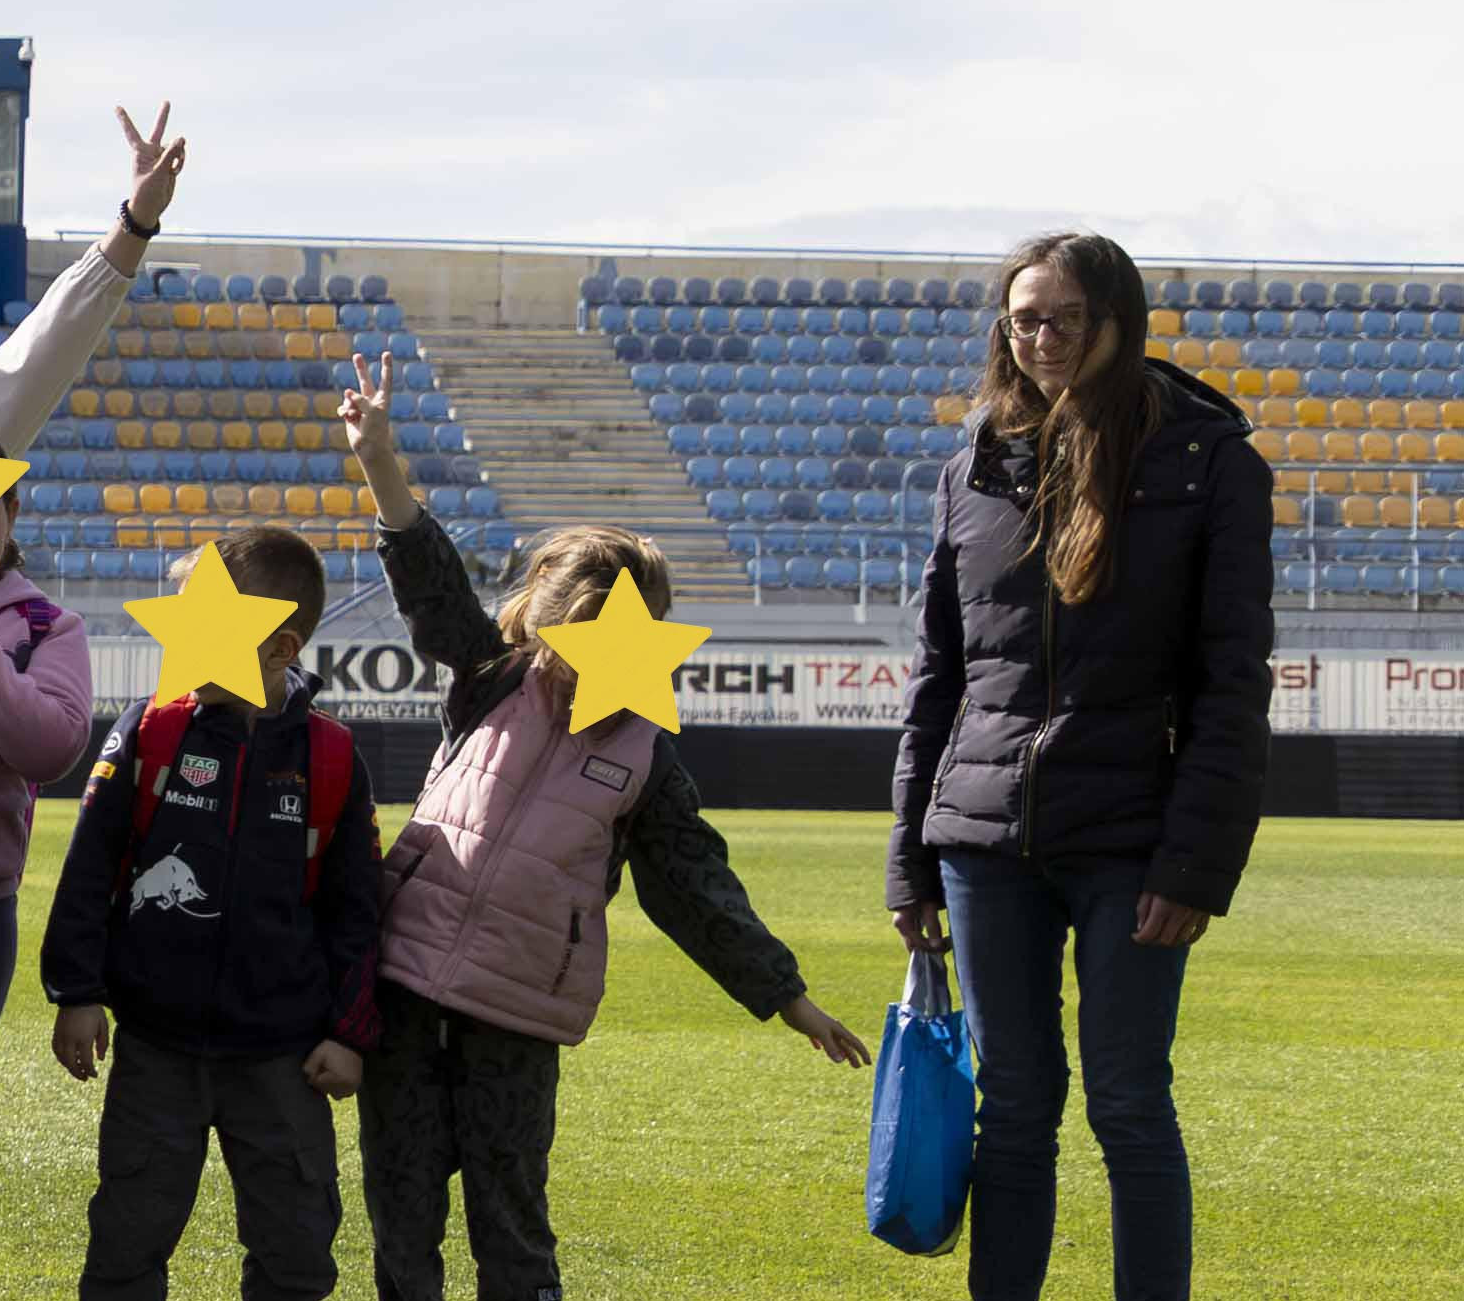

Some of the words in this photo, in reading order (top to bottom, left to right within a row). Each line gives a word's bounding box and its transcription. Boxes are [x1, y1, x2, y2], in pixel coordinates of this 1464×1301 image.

[805, 662, 910, 688] TZA
[187, 757, 216, 771] TAG
[165, 789, 204, 810] Mobil
